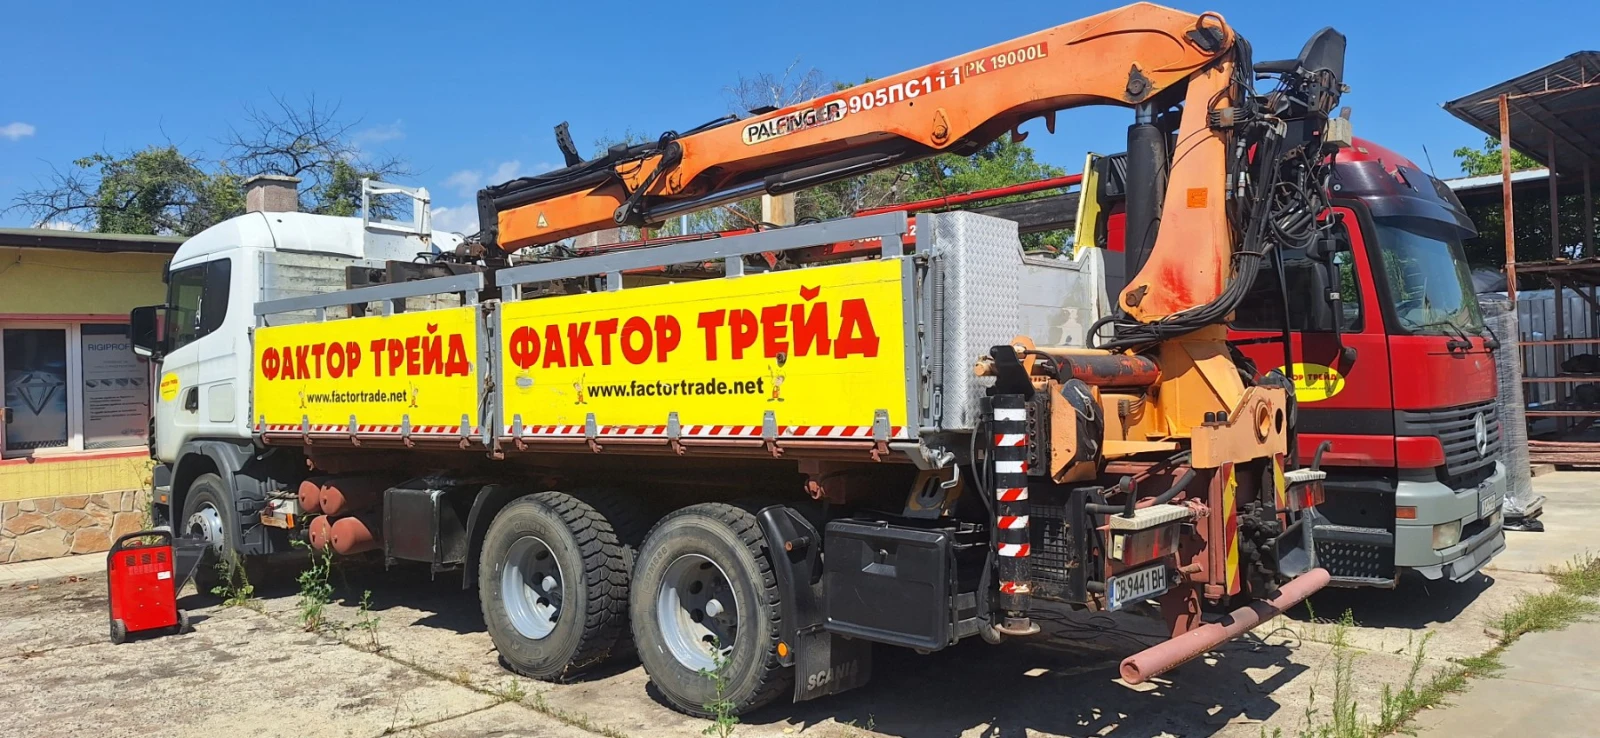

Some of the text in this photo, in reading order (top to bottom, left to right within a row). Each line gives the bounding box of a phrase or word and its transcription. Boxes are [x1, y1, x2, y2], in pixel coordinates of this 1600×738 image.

[990, 43, 1047, 70] 19000L
[509, 284, 880, 369] ФАКТОР ТРЕЙД
[88, 343, 131, 351] RIGIPROF
[261, 322, 470, 380] ФАКТОР ТРЕЙД
[307, 389, 407, 403] www.factortrade.net
[587, 377, 764, 398] www.factortrade.net
[807, 659, 859, 691] SCANIA
